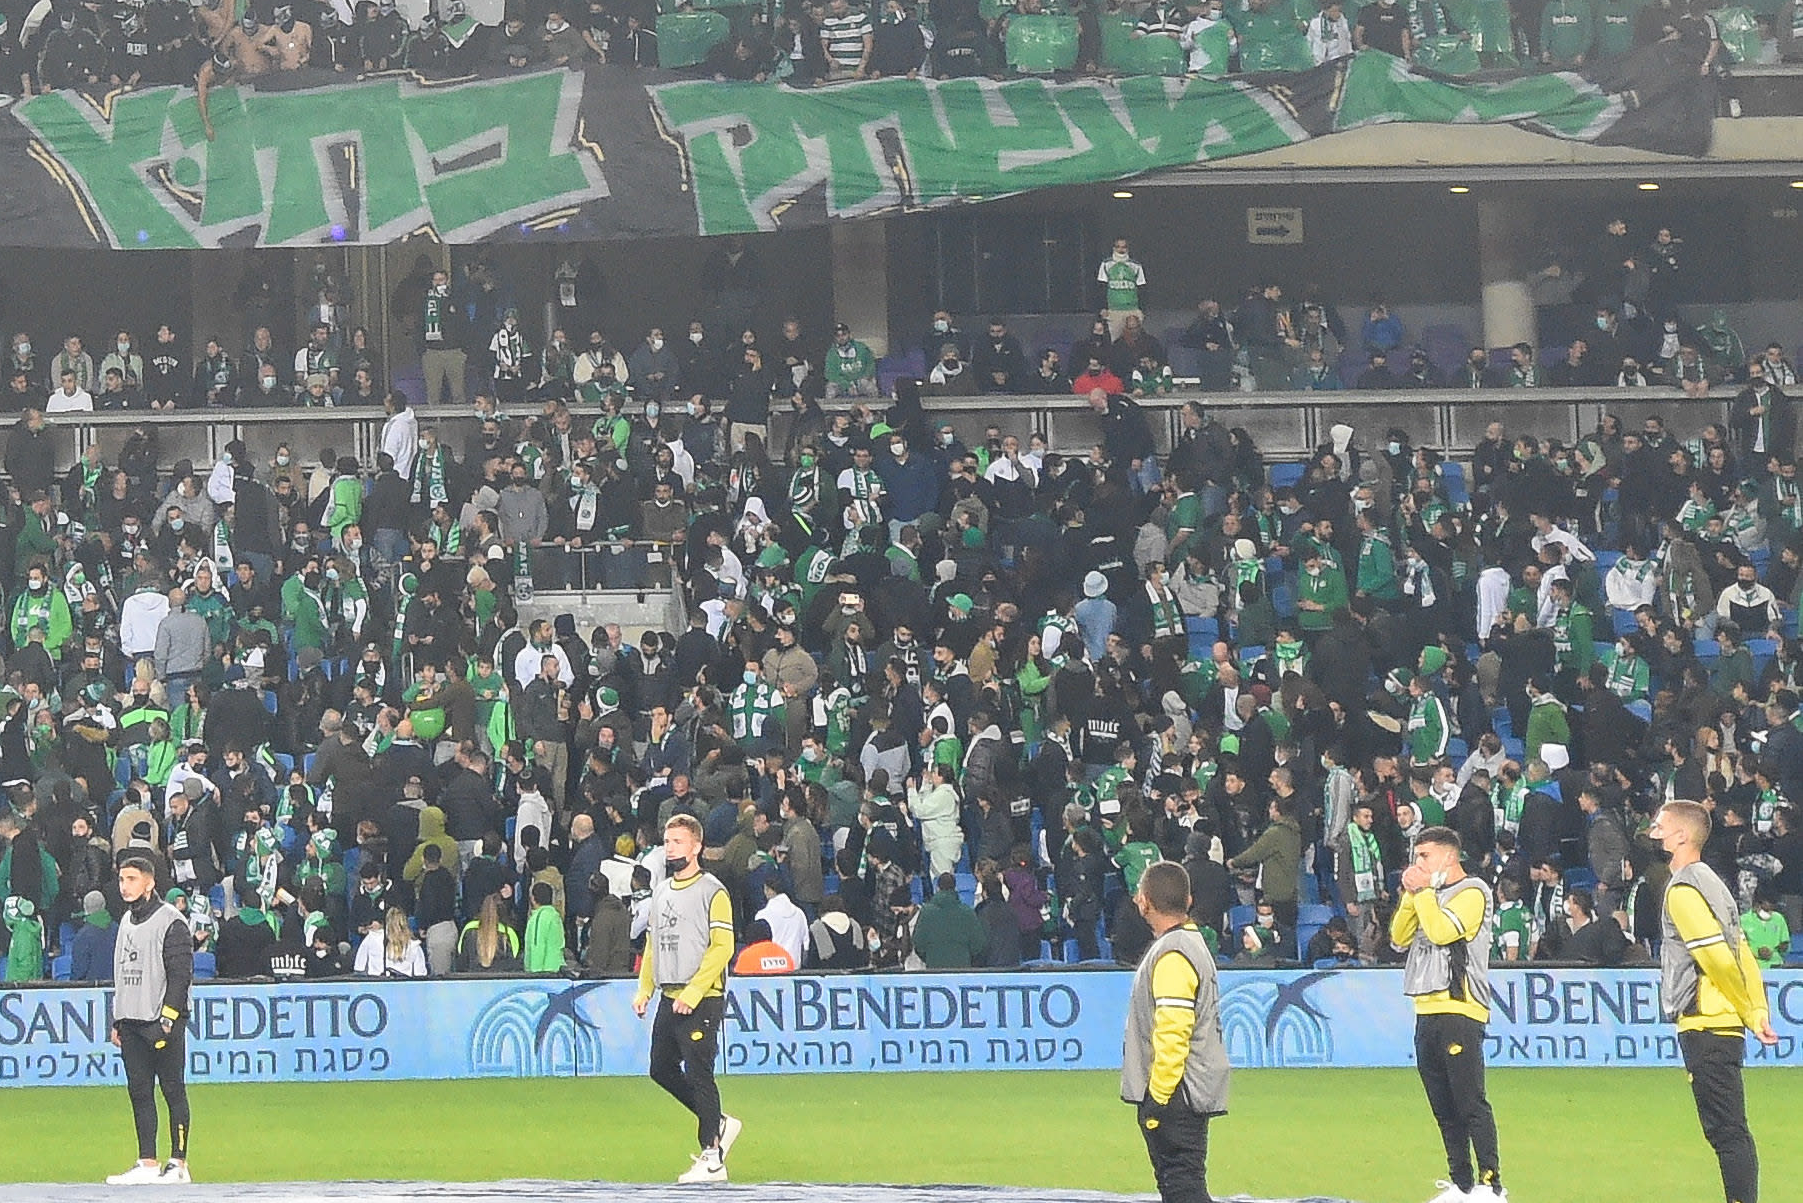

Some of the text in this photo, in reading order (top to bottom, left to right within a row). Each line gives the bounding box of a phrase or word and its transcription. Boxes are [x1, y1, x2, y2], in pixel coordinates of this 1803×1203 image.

[271, 954, 307, 971] mhfc
[293, 1046, 390, 1074] פסגת
[870, 1039, 968, 1071] המים,
[985, 1037, 1083, 1064] פסגת
